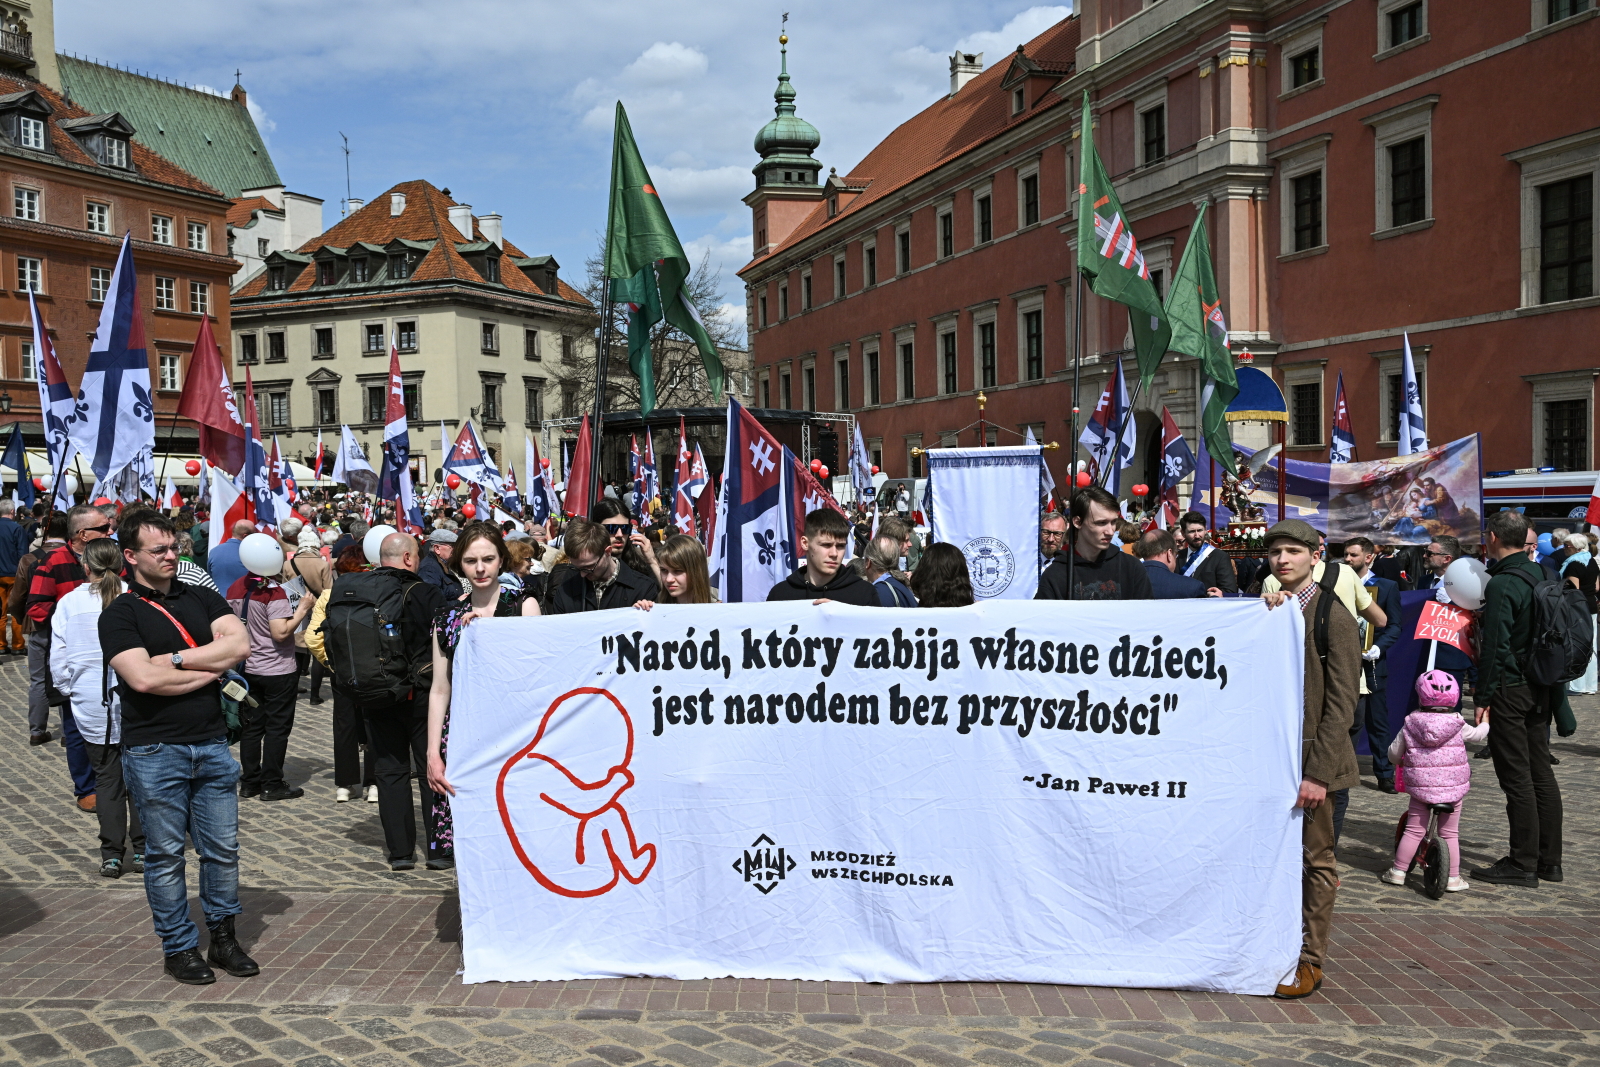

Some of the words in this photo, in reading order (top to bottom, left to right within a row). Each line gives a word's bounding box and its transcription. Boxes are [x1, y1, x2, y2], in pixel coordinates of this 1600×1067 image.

[969, 538, 995, 548] WIEDZY
[1430, 603, 1462, 622] TAK
[1432, 616, 1454, 628] dla
[1418, 622, 1460, 645] ŻYCIA
[601, 627, 731, 679] "Naród,
[741, 625, 844, 677] który
[852, 628, 961, 682] zabija
[969, 628, 1099, 675] własne
[1108, 635, 1228, 690] dzieci,
[652, 685, 714, 736] jest
[723, 682, 880, 725] narodem
[888, 684, 949, 726] bez
[956, 689, 1179, 738] przyszłości"
[1087, 776, 1160, 797] Paweł
[1166, 781, 1188, 799] II
[810, 851, 897, 867] MŁODZIEŻ
[811, 868, 954, 887] WSZECHPOLSKA
